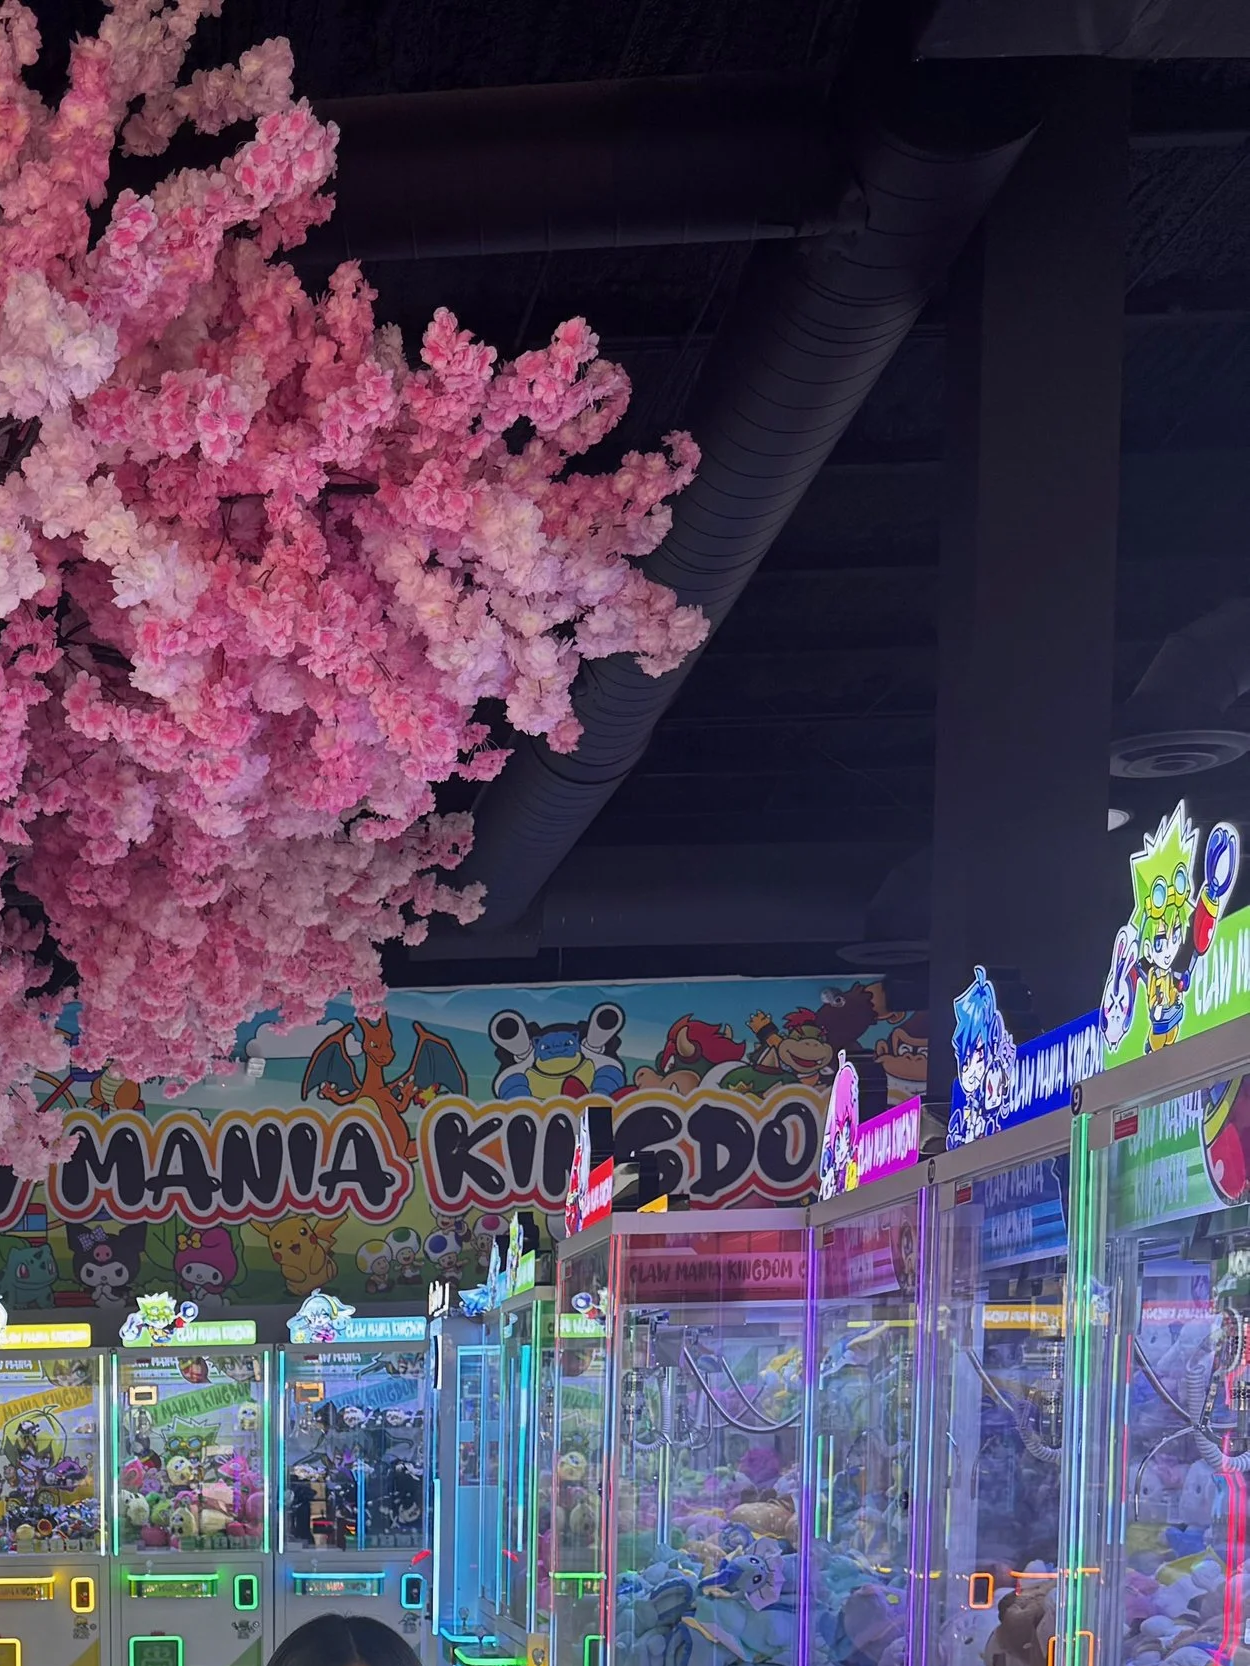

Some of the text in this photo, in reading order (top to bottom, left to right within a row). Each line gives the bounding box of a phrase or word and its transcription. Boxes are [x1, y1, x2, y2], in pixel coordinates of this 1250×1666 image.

[1035, 1041, 1065, 1100] MANIA
[1073, 1087, 1081, 1112] 9
[61, 1122, 397, 1207] MANIA
[675, 1257, 721, 1282] MANIA
[726, 1257, 793, 1281] KINGDOM
[160, 1396, 201, 1420] MANIA
